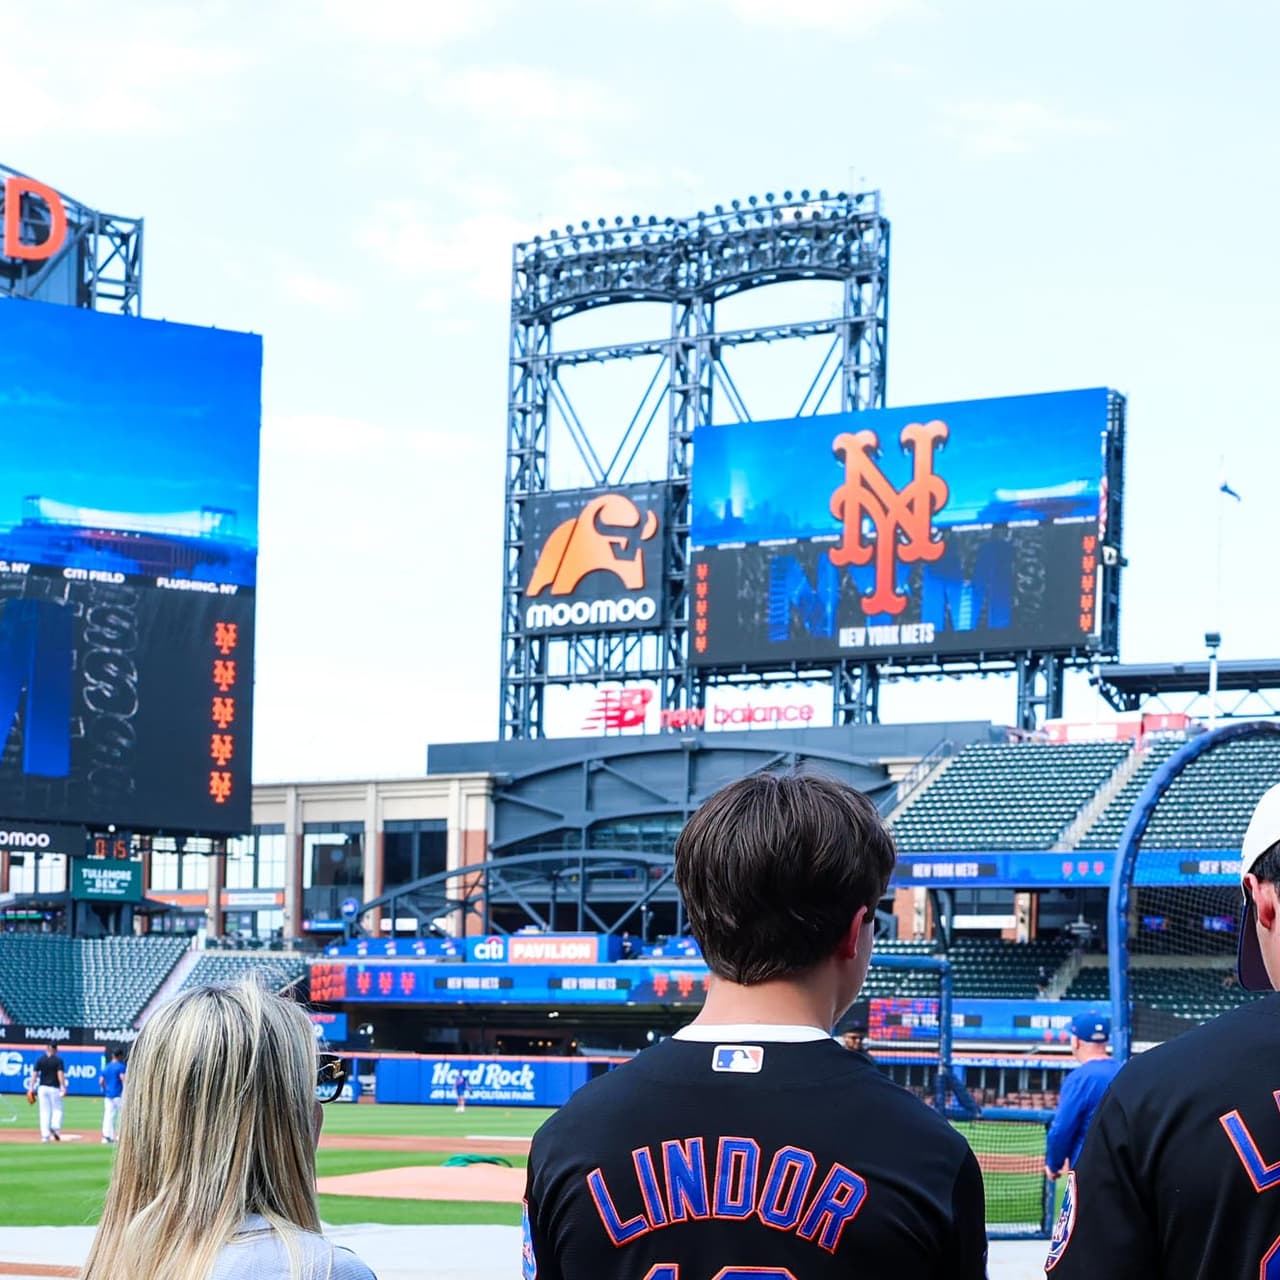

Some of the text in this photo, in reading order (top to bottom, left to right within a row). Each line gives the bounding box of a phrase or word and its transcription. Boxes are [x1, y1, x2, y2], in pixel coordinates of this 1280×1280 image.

[12, 561, 31, 574] NY
[63, 568, 125, 584] CITI FIELD
[220, 583, 239, 596] NY
[526, 596, 656, 629] moomoo
[839, 623, 934, 648] NEW YORK METS
[660, 703, 814, 727] new balance
[513, 943, 591, 960] PAVILION
[25, 1026, 70, 1040] HubSpot
[480, 1064, 535, 1090] Rock
[586, 1136, 869, 1254] LINDOR
